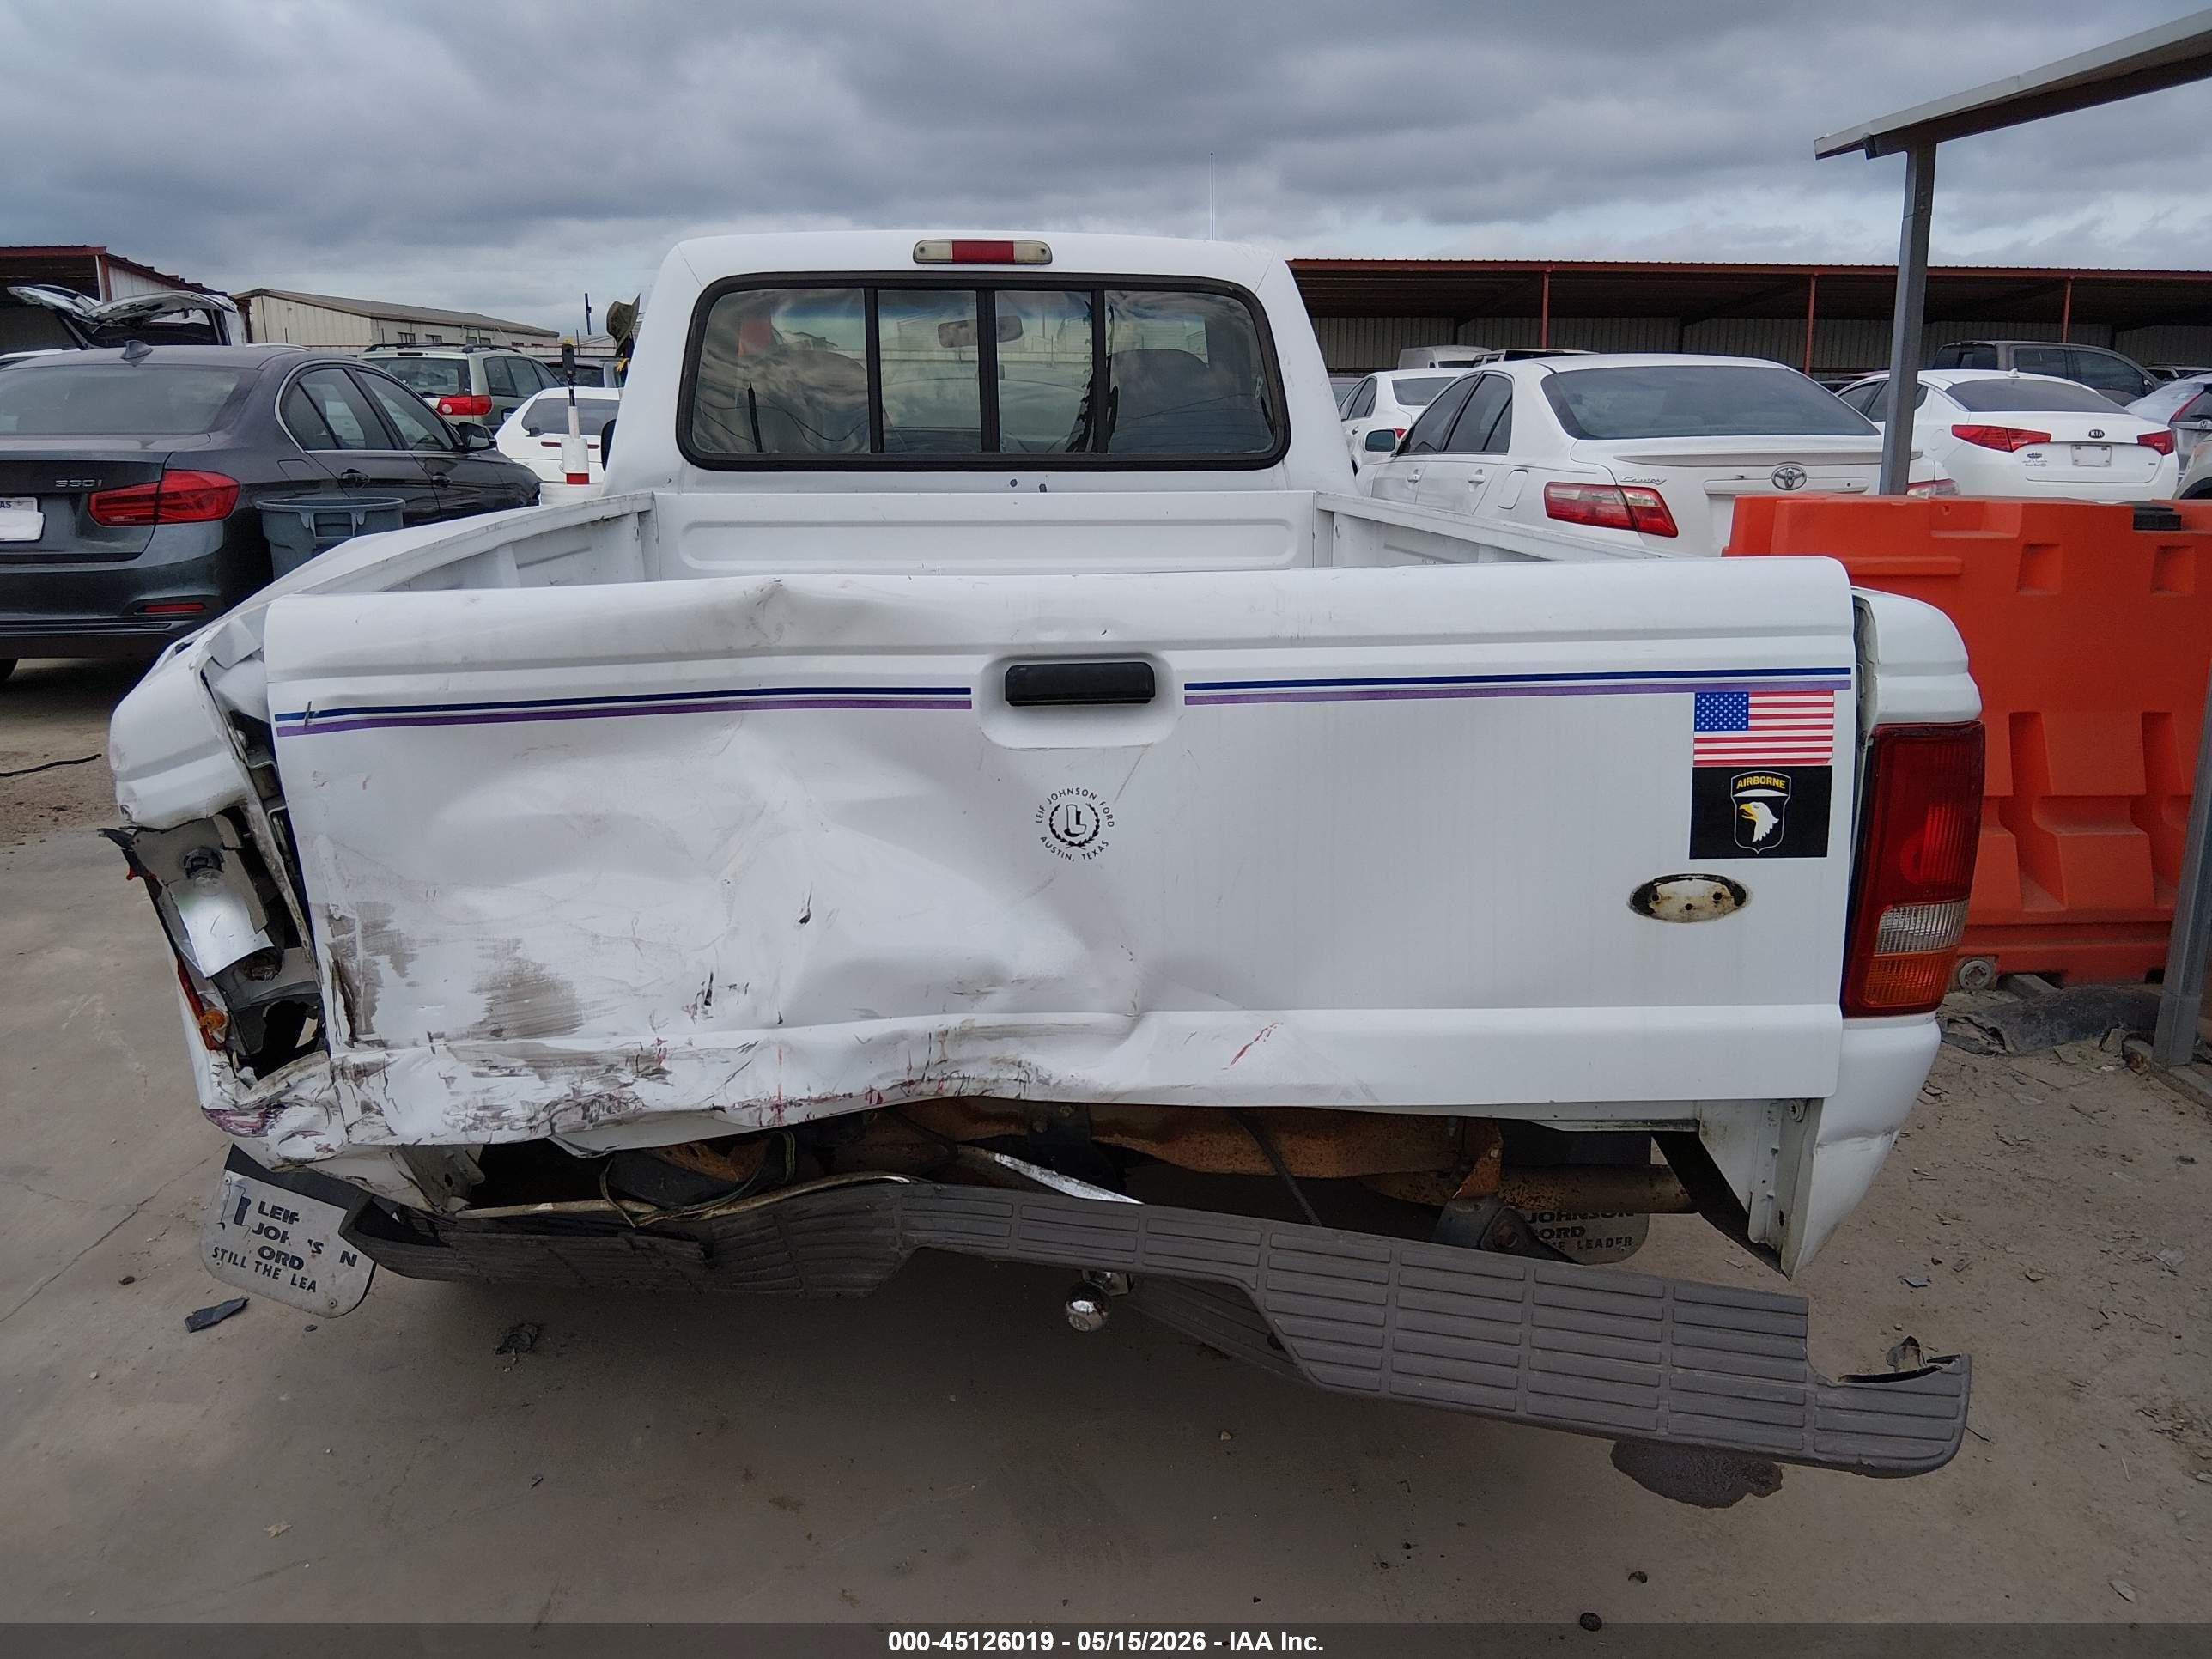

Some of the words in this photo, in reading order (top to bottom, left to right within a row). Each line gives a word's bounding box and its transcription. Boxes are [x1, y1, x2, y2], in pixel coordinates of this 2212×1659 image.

[1736, 775, 1786, 790] AIRBORNE
[1035, 805, 1047, 823] LEIF
[1046, 787, 1097, 805] JOHNSON
[1098, 800, 1115, 828] FORD
[1063, 804, 1087, 838] L
[1081, 839, 1109, 861] TEXAS
[257, 1200, 300, 1224] LEIF
[1538, 1226, 1586, 1239] ORD
[1577, 1236, 1632, 1250] LEADER
[212, 1246, 246, 1268] STILL
[254, 1261, 282, 1280] THE
[258, 1245, 304, 1271] ORD
